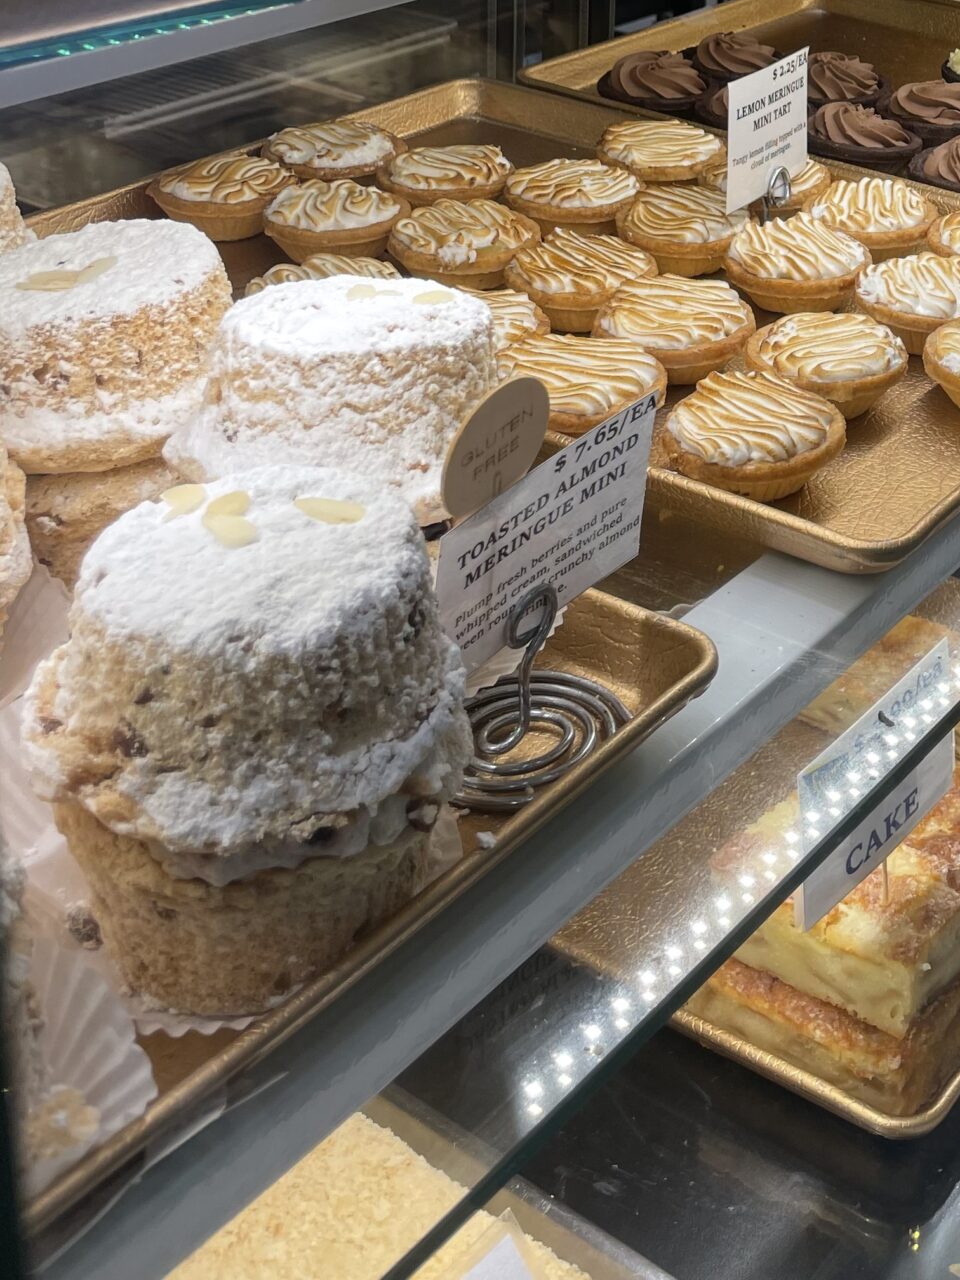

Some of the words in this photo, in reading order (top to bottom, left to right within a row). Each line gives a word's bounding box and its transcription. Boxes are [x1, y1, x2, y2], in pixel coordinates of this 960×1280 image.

[736, 96, 766, 121] LEMON
[768, 76, 804, 104] MERINGUE
[772, 69, 778, 80] $
[780, 51, 807, 76] 2.25/EA
[753, 112, 772, 132] MINI
[773, 101, 792, 119] TART
[732, 154, 748, 167] Tangy
[749, 145, 764, 159] lemon
[751, 156, 764, 170] cloud
[764, 152, 770, 162] of
[460, 403, 534, 468] GLUTEN
[472, 437, 521, 481] FREE
[554, 454, 567, 474] $
[574, 394, 657, 464] 7.65/EA
[457, 493, 550, 570] TOASTED
[554, 433, 639, 500] ALMOND
[463, 498, 574, 590] MERINGUE
[578, 461, 627, 509] MINI
[454, 592, 493, 628] Plump
[497, 567, 528, 595] fresh
[531, 534, 573, 566] berries
[576, 515, 598, 538] and
[601, 496, 628, 524] pure
[455, 596, 507, 641] whipped
[510, 566, 552, 599] cream,
[554, 513, 623, 566] sandwiched
[548, 548, 596, 584] crunchy
[598, 515, 641, 551] almond
[845, 787, 921, 875] CAKE
